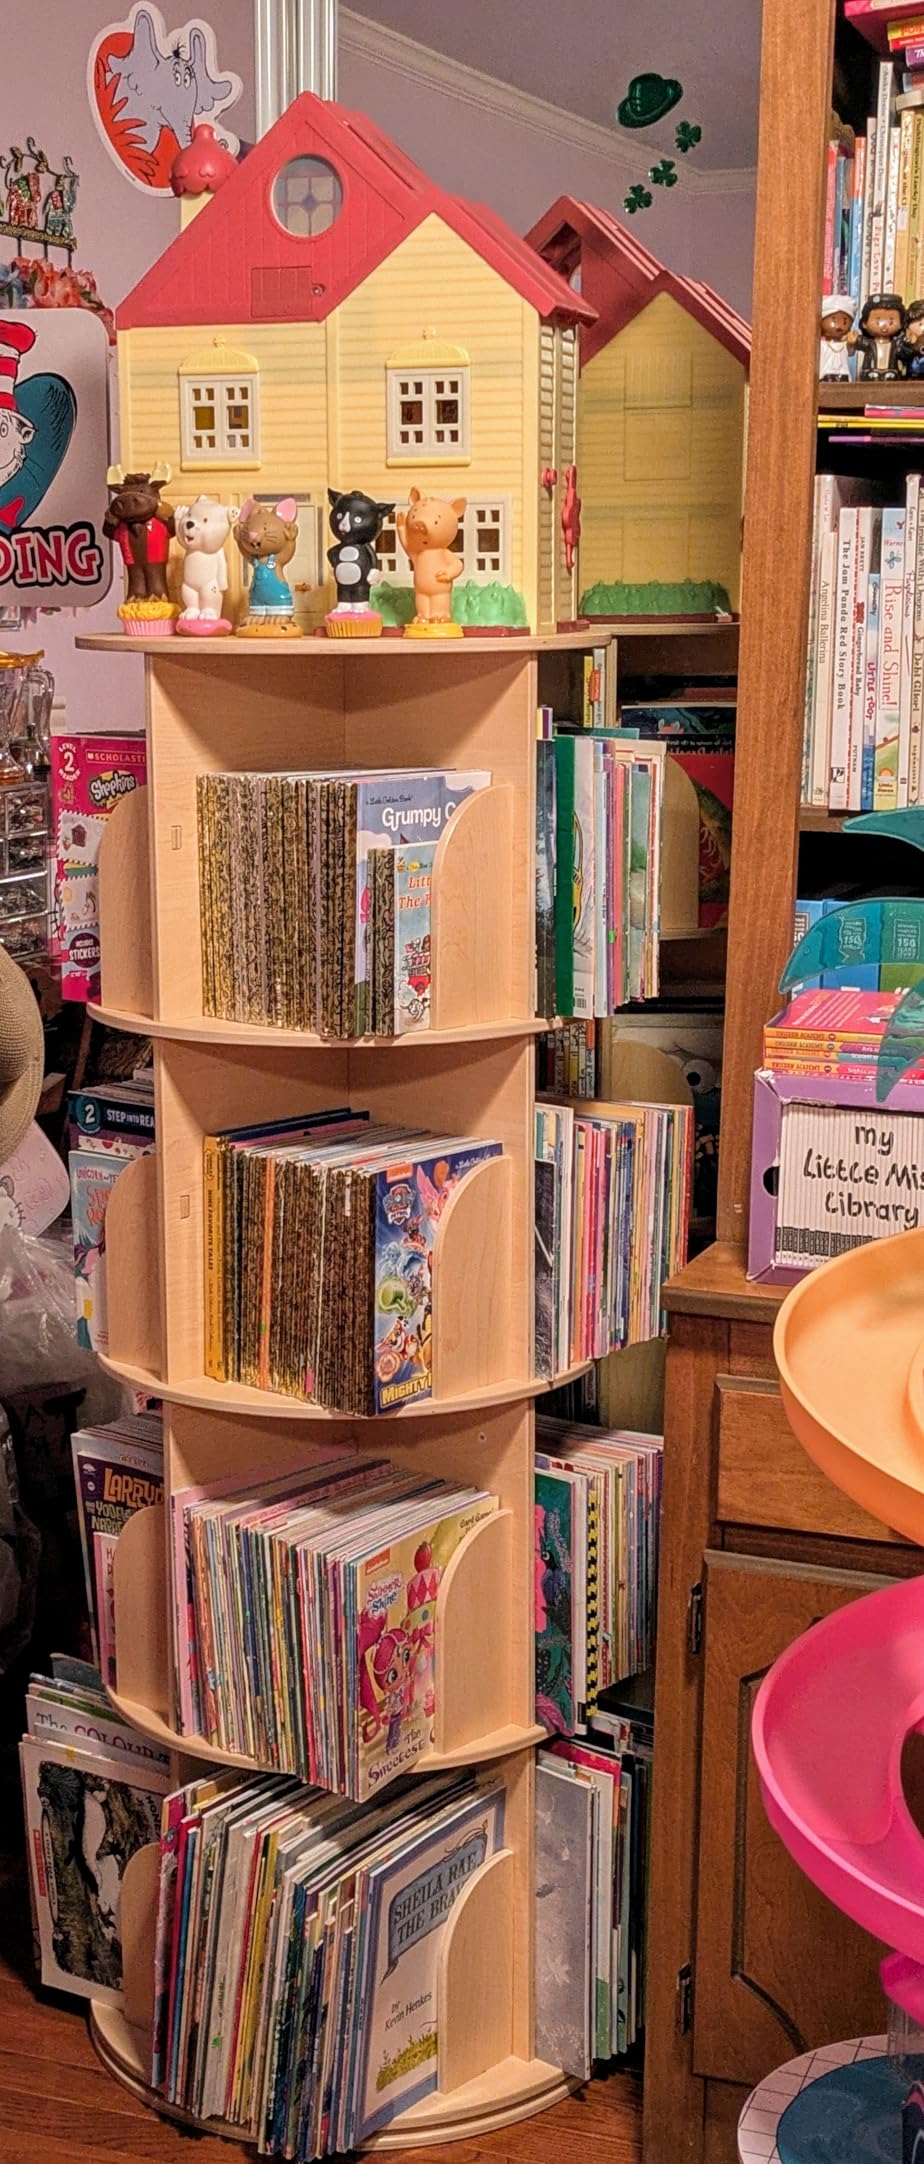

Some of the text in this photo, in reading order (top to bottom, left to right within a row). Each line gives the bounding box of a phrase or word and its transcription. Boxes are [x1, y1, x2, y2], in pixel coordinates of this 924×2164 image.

[884, 584, 903, 620] Rise
[818, 580, 830, 664] Angelina Ballerina
[836, 538, 851, 710] The Jam Panda Red Story Book
[855, 626, 864, 675] Gingerbread
[883, 626, 899, 654] and
[853, 677, 863, 697] Baby
[866, 661, 877, 693] LITTLE
[881, 660, 899, 706] Shine!
[865, 695, 876, 721] TOOT
[63, 751, 75, 772] 2
[382, 807, 441, 832] Grumpy
[399, 895, 420, 910] The
[69, 945, 101, 961] STICKERS
[84, 1103, 96, 1124] 2
[106, 1108, 126, 1123] STEP
[126, 1113, 140, 1124] INTO
[854, 1125, 894, 1156] my
[803, 1147, 880, 1186] Little
[824, 1191, 919, 1231] Library
[381, 1376, 427, 1405] MIGHTY
[393, 1874, 443, 1925] SHEILA
[397, 1911, 425, 1946] THE
[384, 1991, 432, 2032] Kevin Henkes
[391, 2001, 401, 2014] by
